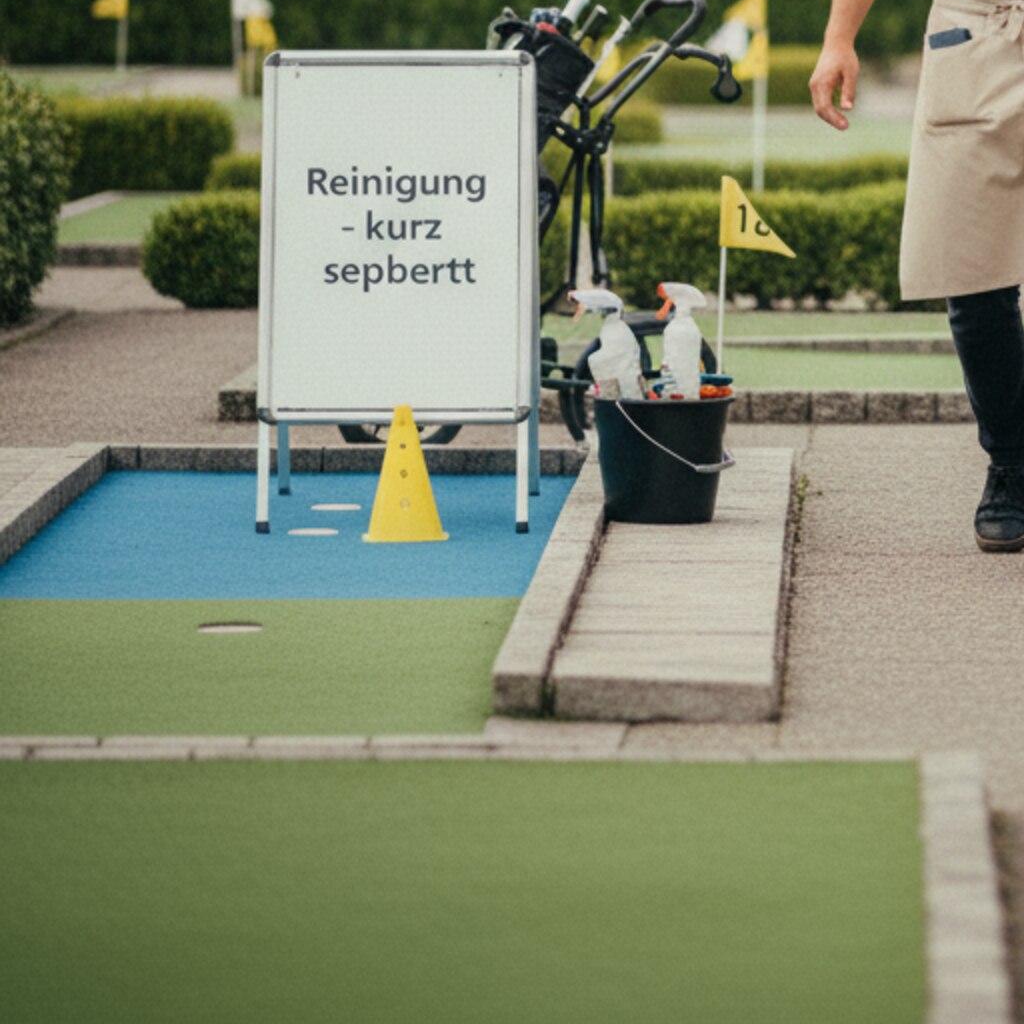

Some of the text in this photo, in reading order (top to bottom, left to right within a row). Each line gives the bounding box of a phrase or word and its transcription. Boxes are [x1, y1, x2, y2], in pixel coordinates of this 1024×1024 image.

[306, 165, 487, 204] Reinigung
[365, 209, 442, 241] kurz
[323, 253, 477, 293] sepbertt
